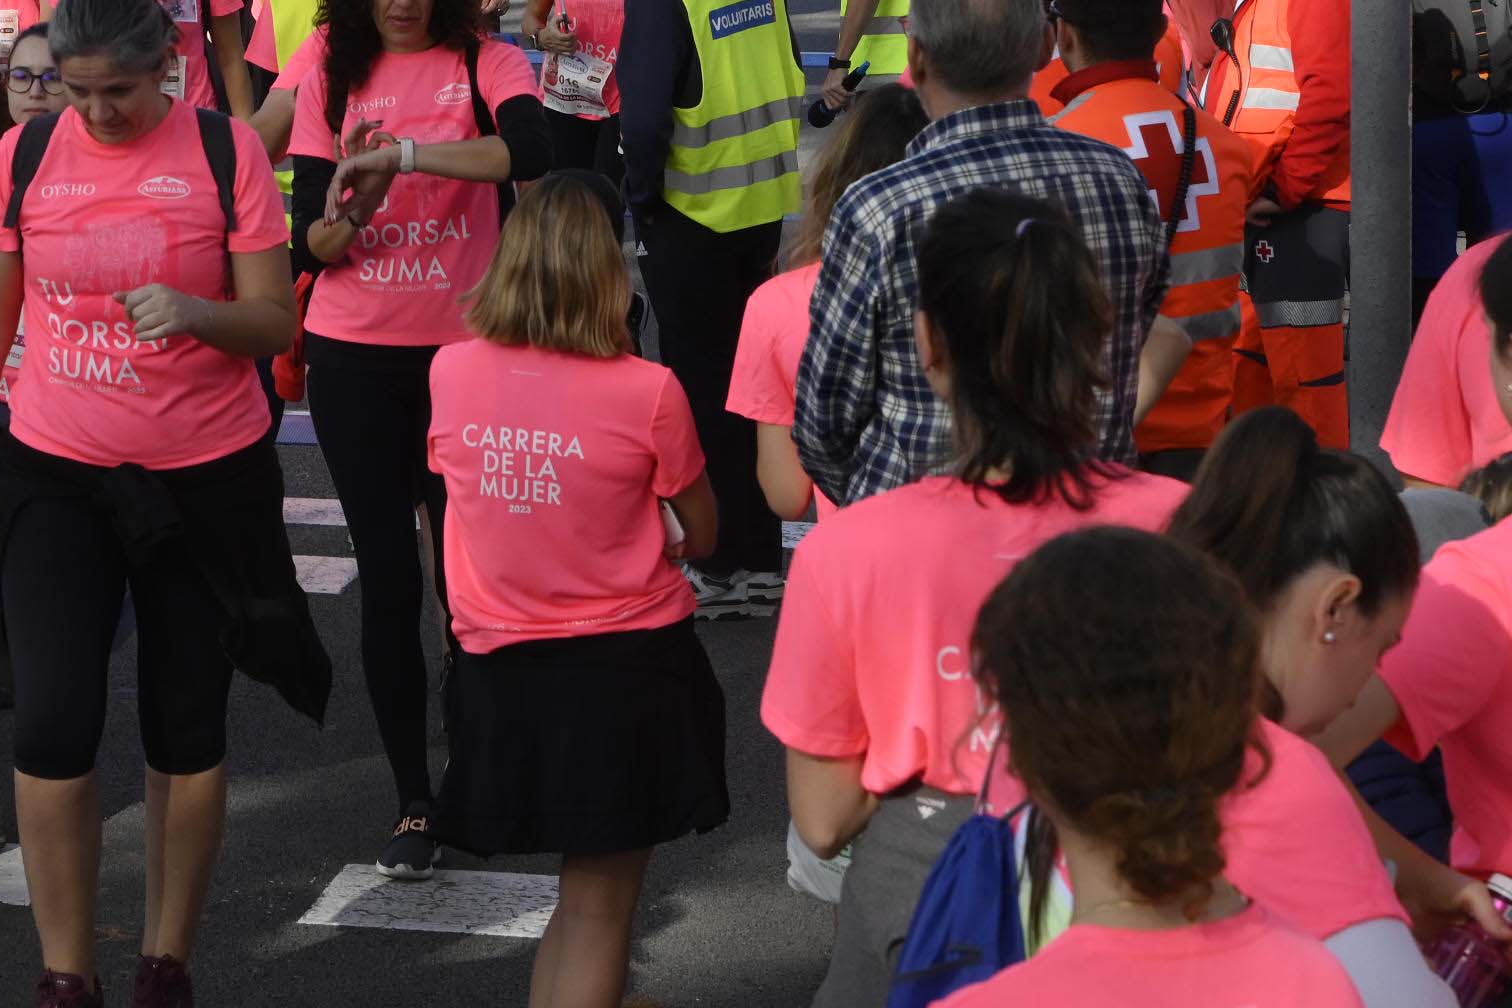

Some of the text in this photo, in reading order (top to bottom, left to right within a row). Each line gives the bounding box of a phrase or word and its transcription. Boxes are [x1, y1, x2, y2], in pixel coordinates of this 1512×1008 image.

[711, 2, 774, 31] VOLUNTARIS
[350, 96, 397, 113] OYSHO
[41, 183, 96, 199] OYSHO
[142, 184, 186, 194] ASTURIANA
[359, 214, 471, 248] DORSAL
[359, 255, 448, 283] SUMA
[38, 277, 73, 305] TU
[48, 346, 141, 385] SUMA
[462, 423, 585, 460] CARRERA
[483, 450, 558, 481] DE LA
[479, 474, 562, 505] MUJER
[508, 503, 532, 514] 2023
